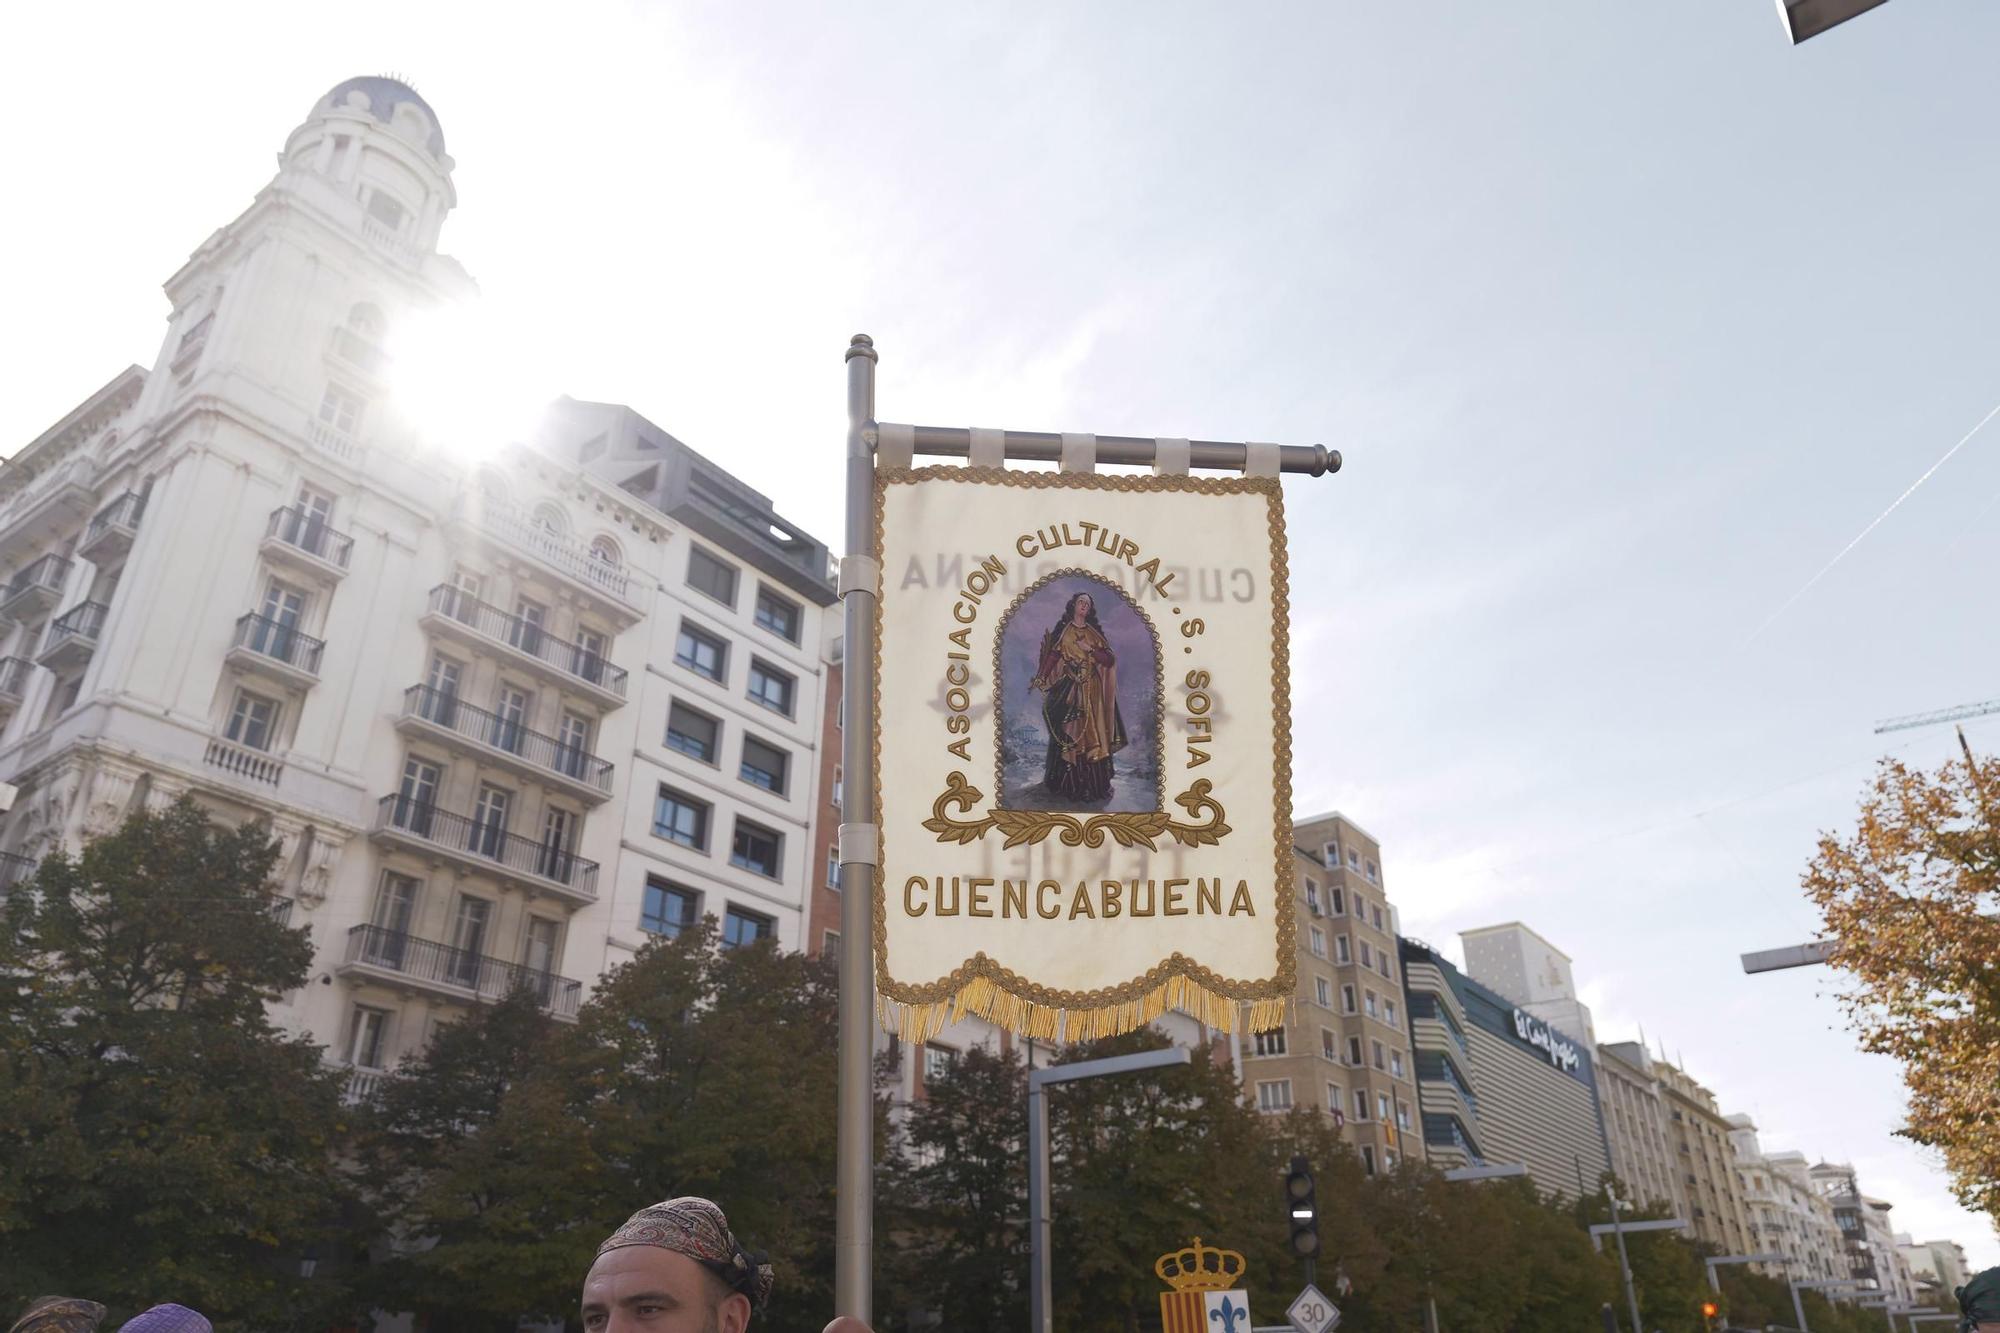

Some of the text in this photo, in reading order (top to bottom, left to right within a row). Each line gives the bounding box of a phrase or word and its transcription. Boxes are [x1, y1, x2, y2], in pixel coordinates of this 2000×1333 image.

[945, 554, 1008, 762] ASOCIACION
[1185, 669, 1212, 770] SOFIA
[903, 875, 1256, 921] CUENCABUENA
[1300, 1302, 1325, 1324] 30
